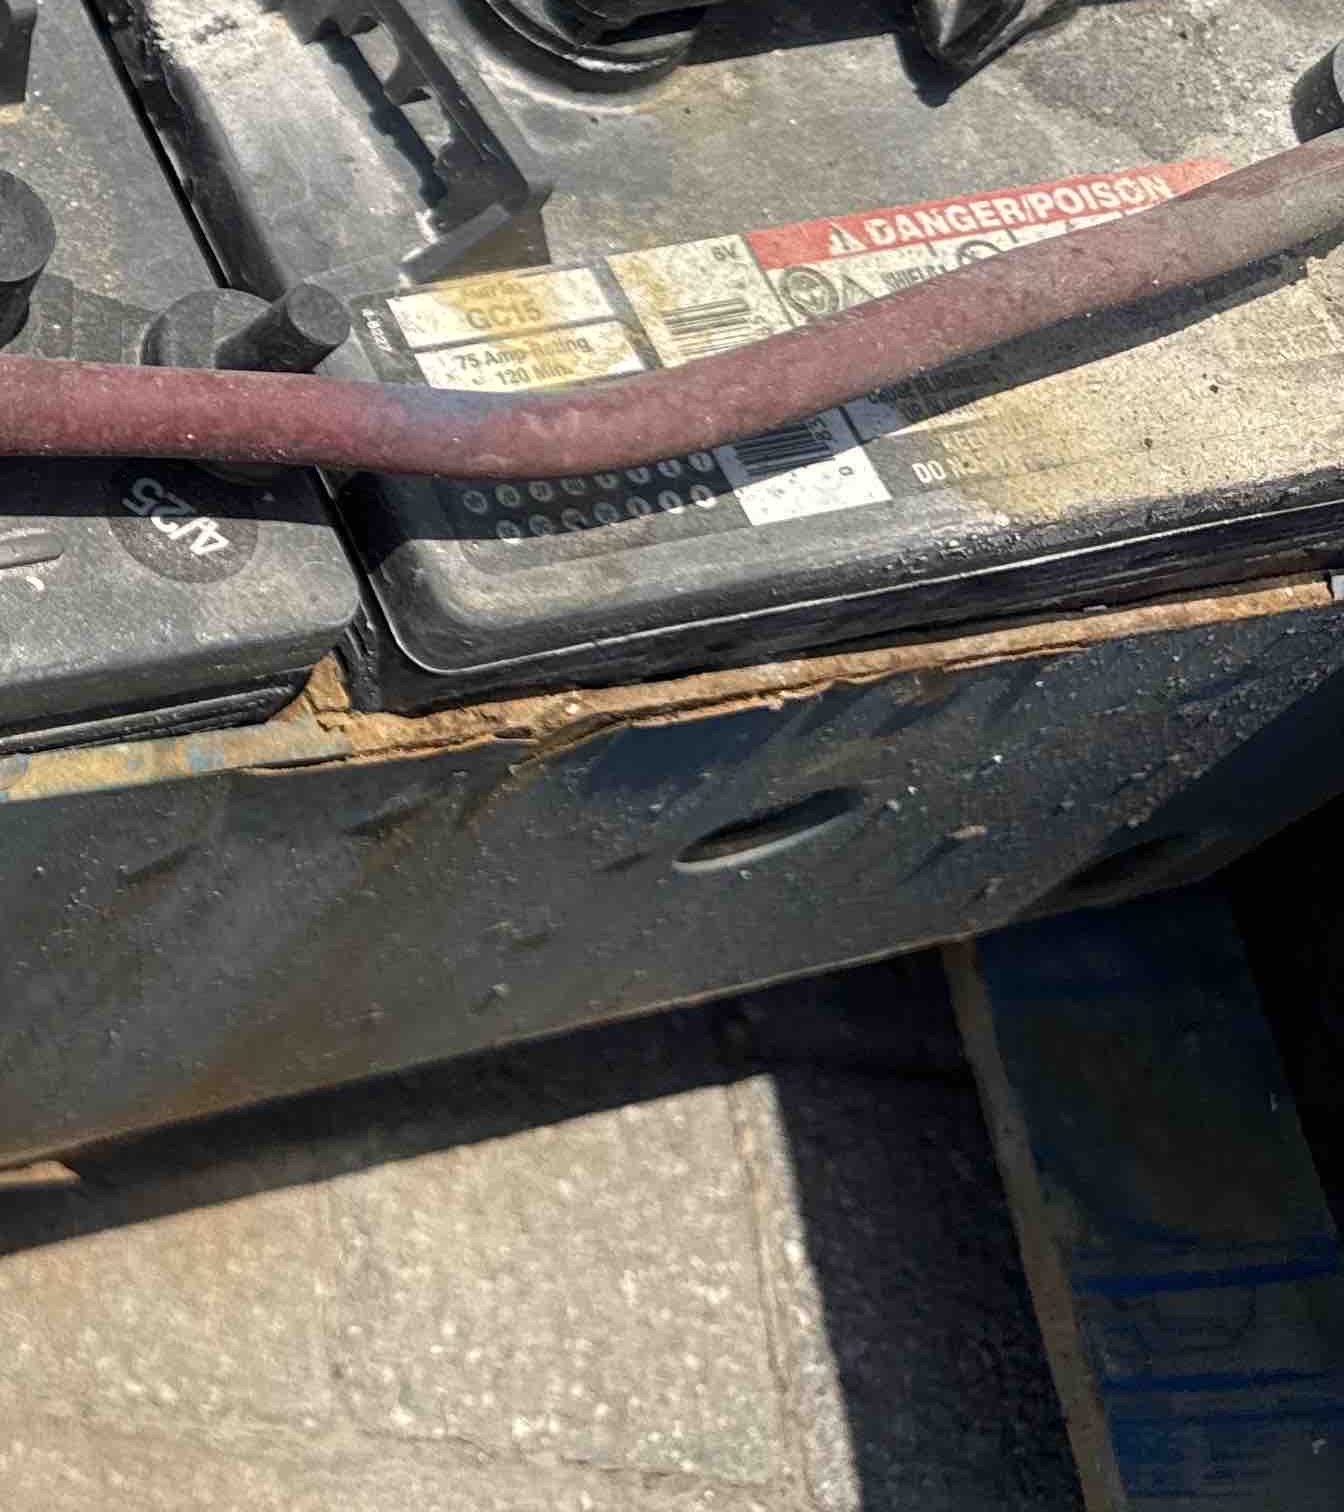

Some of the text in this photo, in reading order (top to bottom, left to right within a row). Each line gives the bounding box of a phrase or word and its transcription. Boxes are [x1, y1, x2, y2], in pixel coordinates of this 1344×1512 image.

[865, 163, 1174, 253] DANGER/POISON
[463, 295, 544, 333] GC15
[453, 344, 527, 371] 75 Amp
[495, 364, 530, 387] 120
